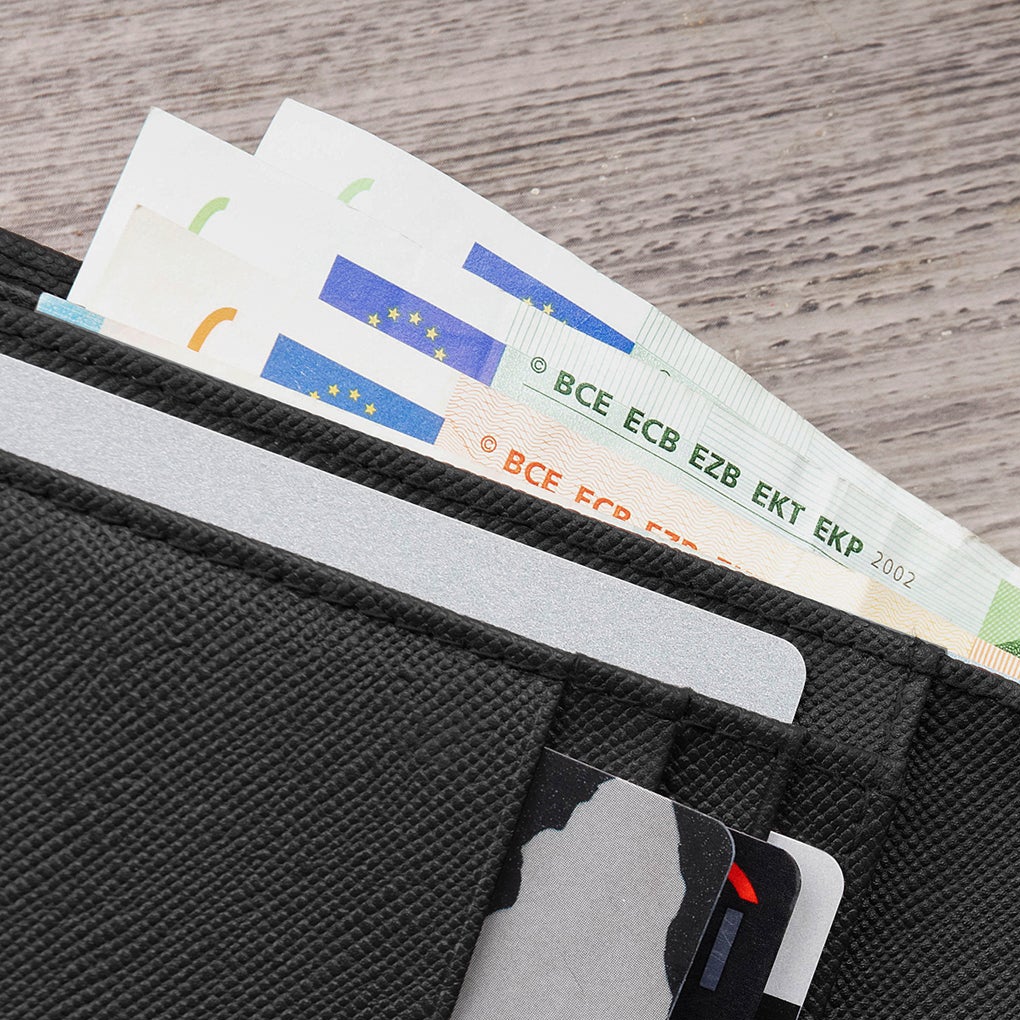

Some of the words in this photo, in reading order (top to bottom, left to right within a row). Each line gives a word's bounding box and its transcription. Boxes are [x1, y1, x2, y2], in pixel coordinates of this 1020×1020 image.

[502, 448, 563, 494] BCE
[553, 369, 614, 418] BCE
[623, 406, 681, 454] ECB
[688, 442, 741, 490] EZB
[751, 480, 807, 526] EKT
[813, 515, 864, 559] EKP
[869, 550, 918, 590] 2002
